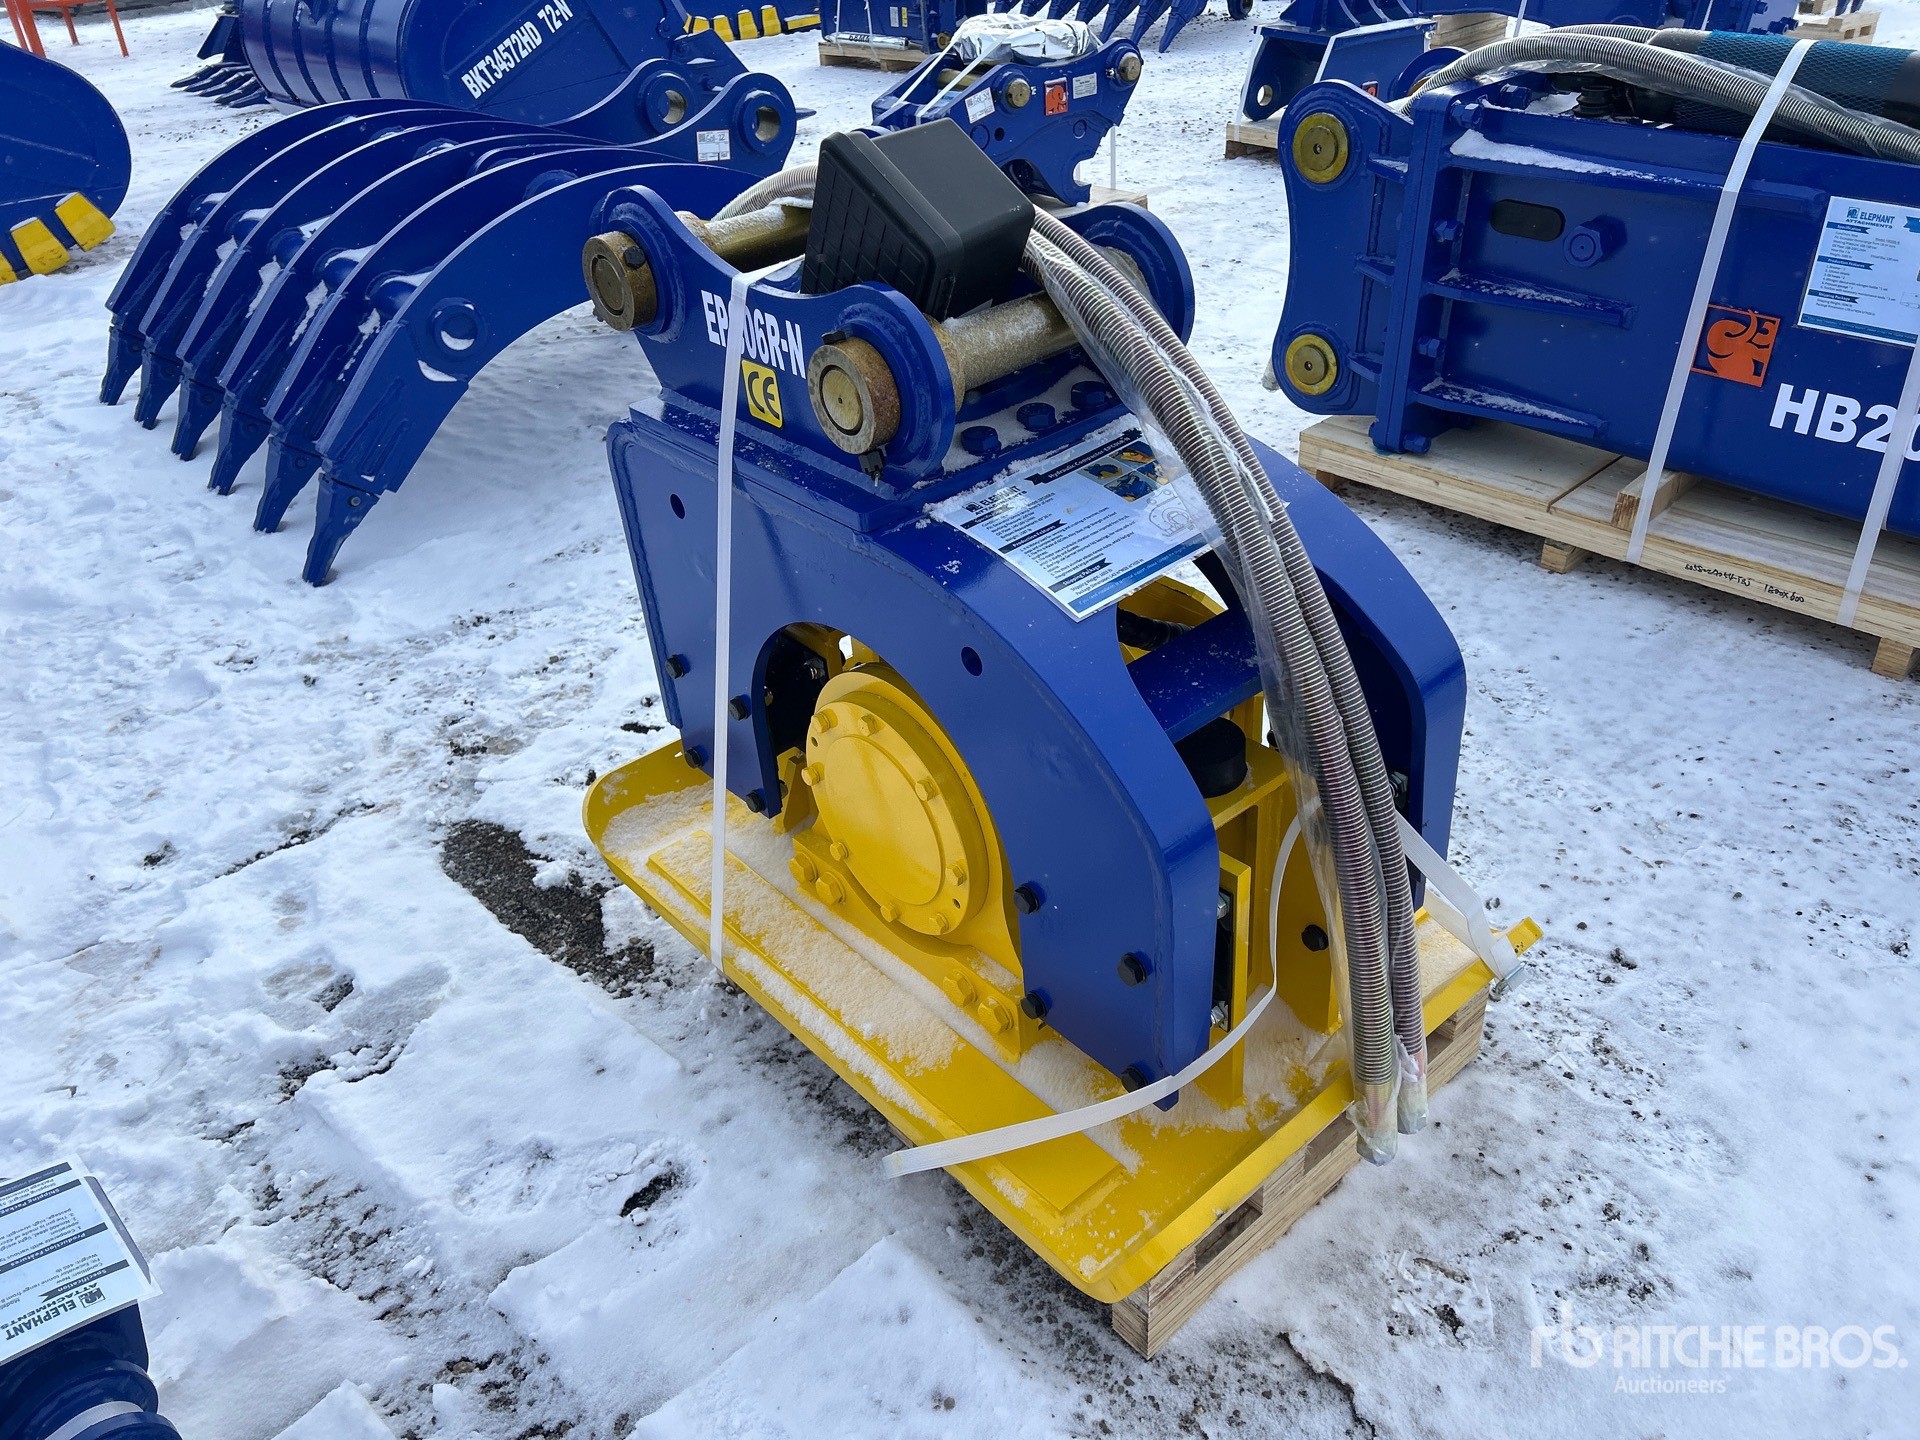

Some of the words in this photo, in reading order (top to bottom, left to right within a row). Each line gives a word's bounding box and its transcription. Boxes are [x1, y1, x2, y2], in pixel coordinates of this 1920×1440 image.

[461, 21, 542, 99] BKT34572HD
[1845, 218, 1892, 229] ATTACHMENTS
[1859, 211, 1894, 224] ELEPHANT
[701, 290, 806, 380] EP06R-N
[1011, 533, 1037, 547] Production
[1061, 573, 1083, 586] Shipping
[1080, 563, 1101, 576] Package
[26, 1187, 59, 1203] Shipping
[44, 1232, 85, 1252] Production
[10, 1250, 43, 1267] Features
[57, 1268, 106, 1293] Specification
[0, 1281, 98, 1330] ATTACHMENTS
[4, 1298, 76, 1340] ELEPHANT
